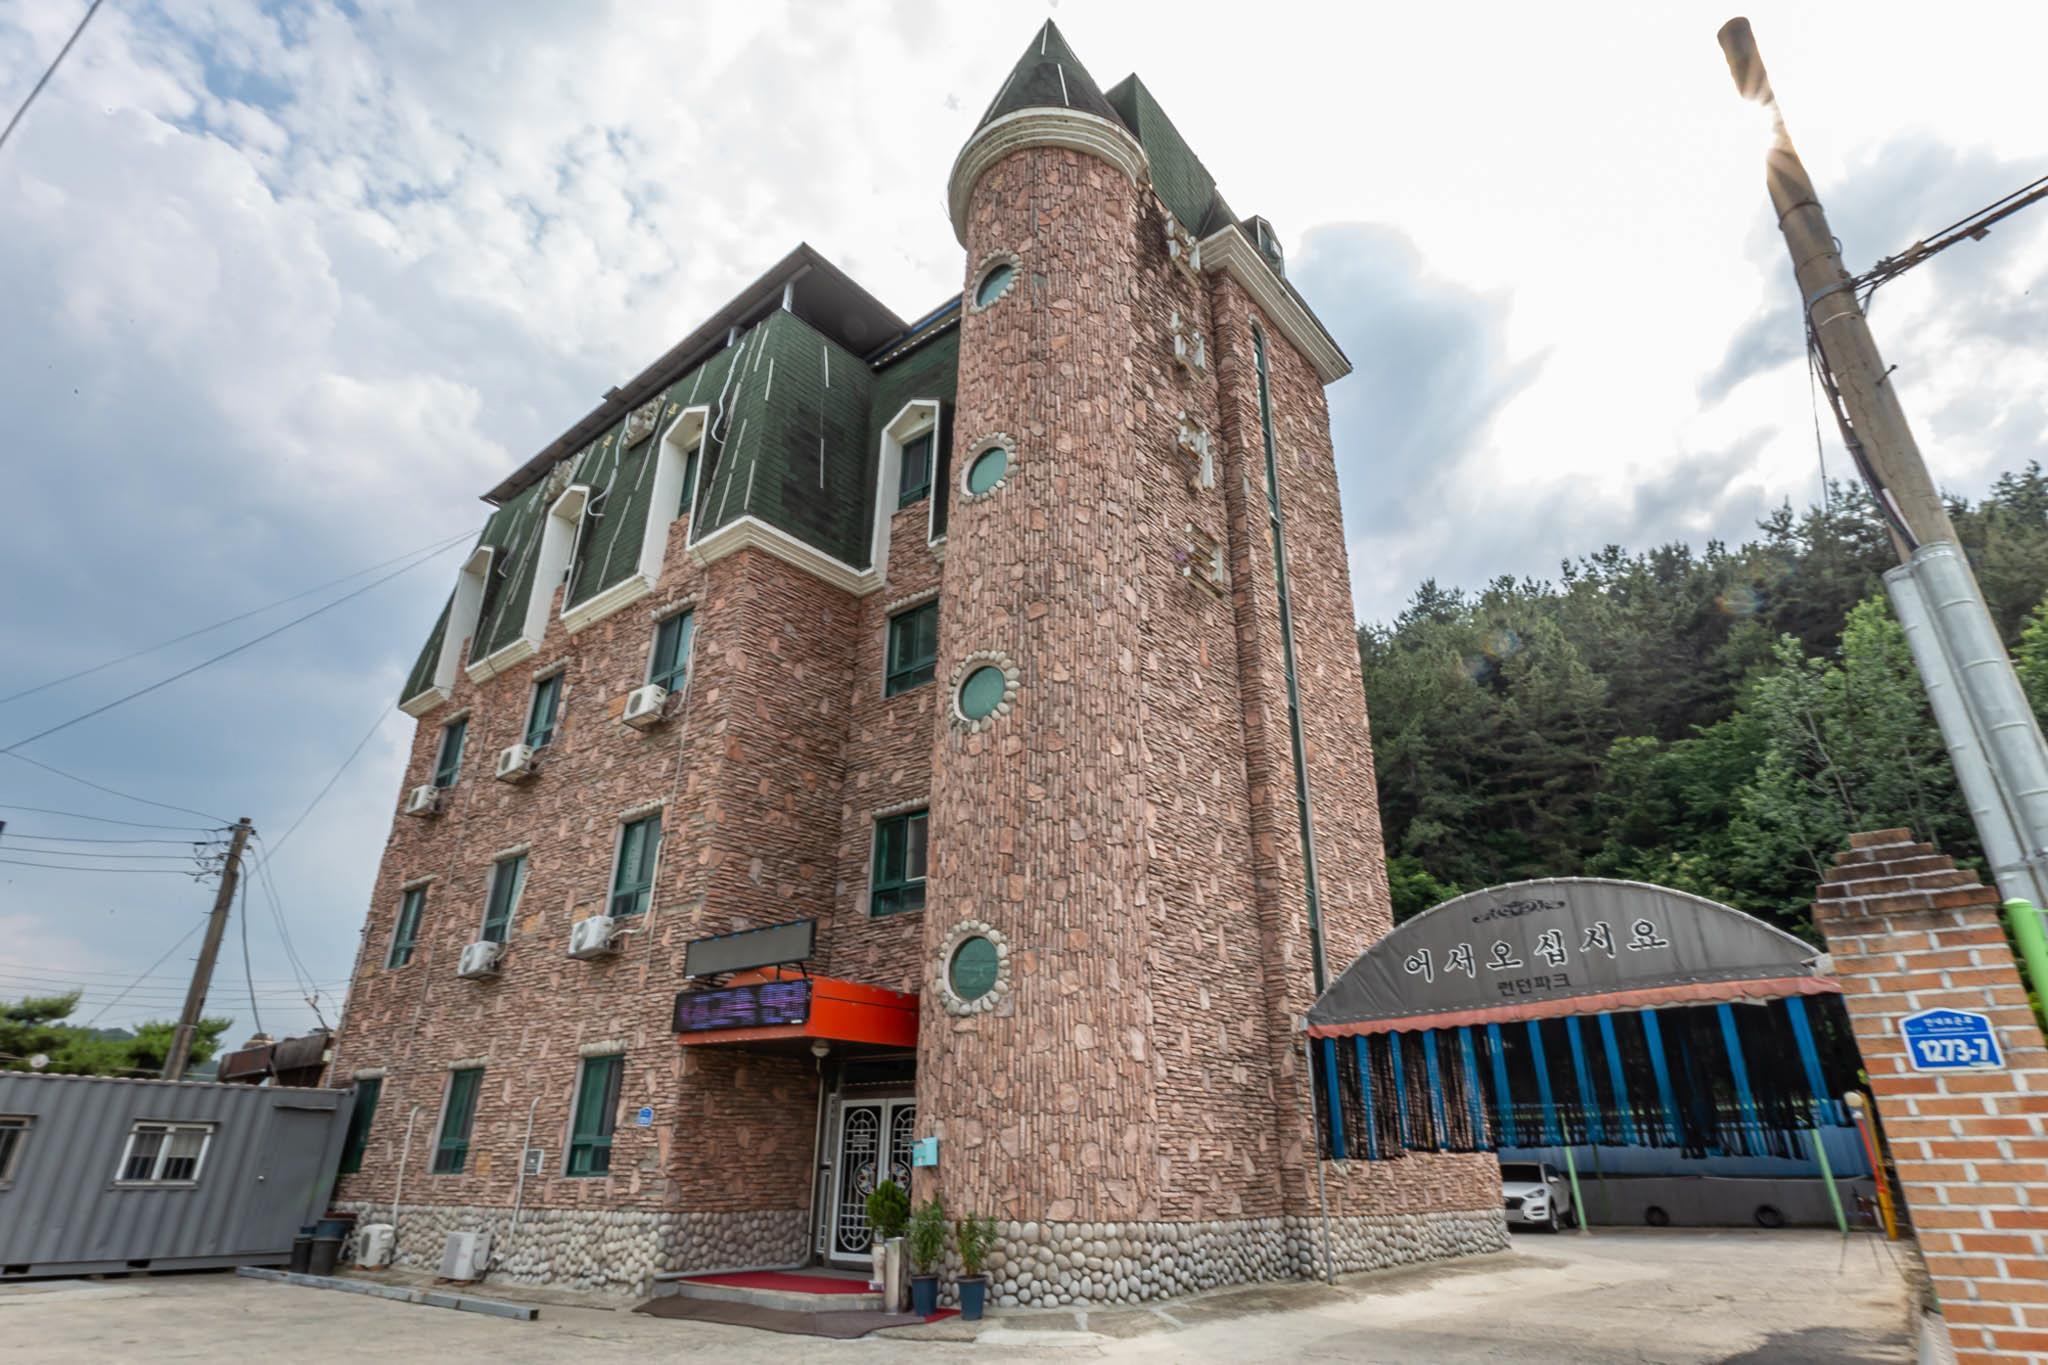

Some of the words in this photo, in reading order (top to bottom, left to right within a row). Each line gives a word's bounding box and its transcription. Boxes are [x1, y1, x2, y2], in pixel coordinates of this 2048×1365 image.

[1404, 919, 1669, 983] 어서오십시요
[1497, 973, 1571, 997] 런던파크
[1917, 1038, 1989, 1062] 1273-7
